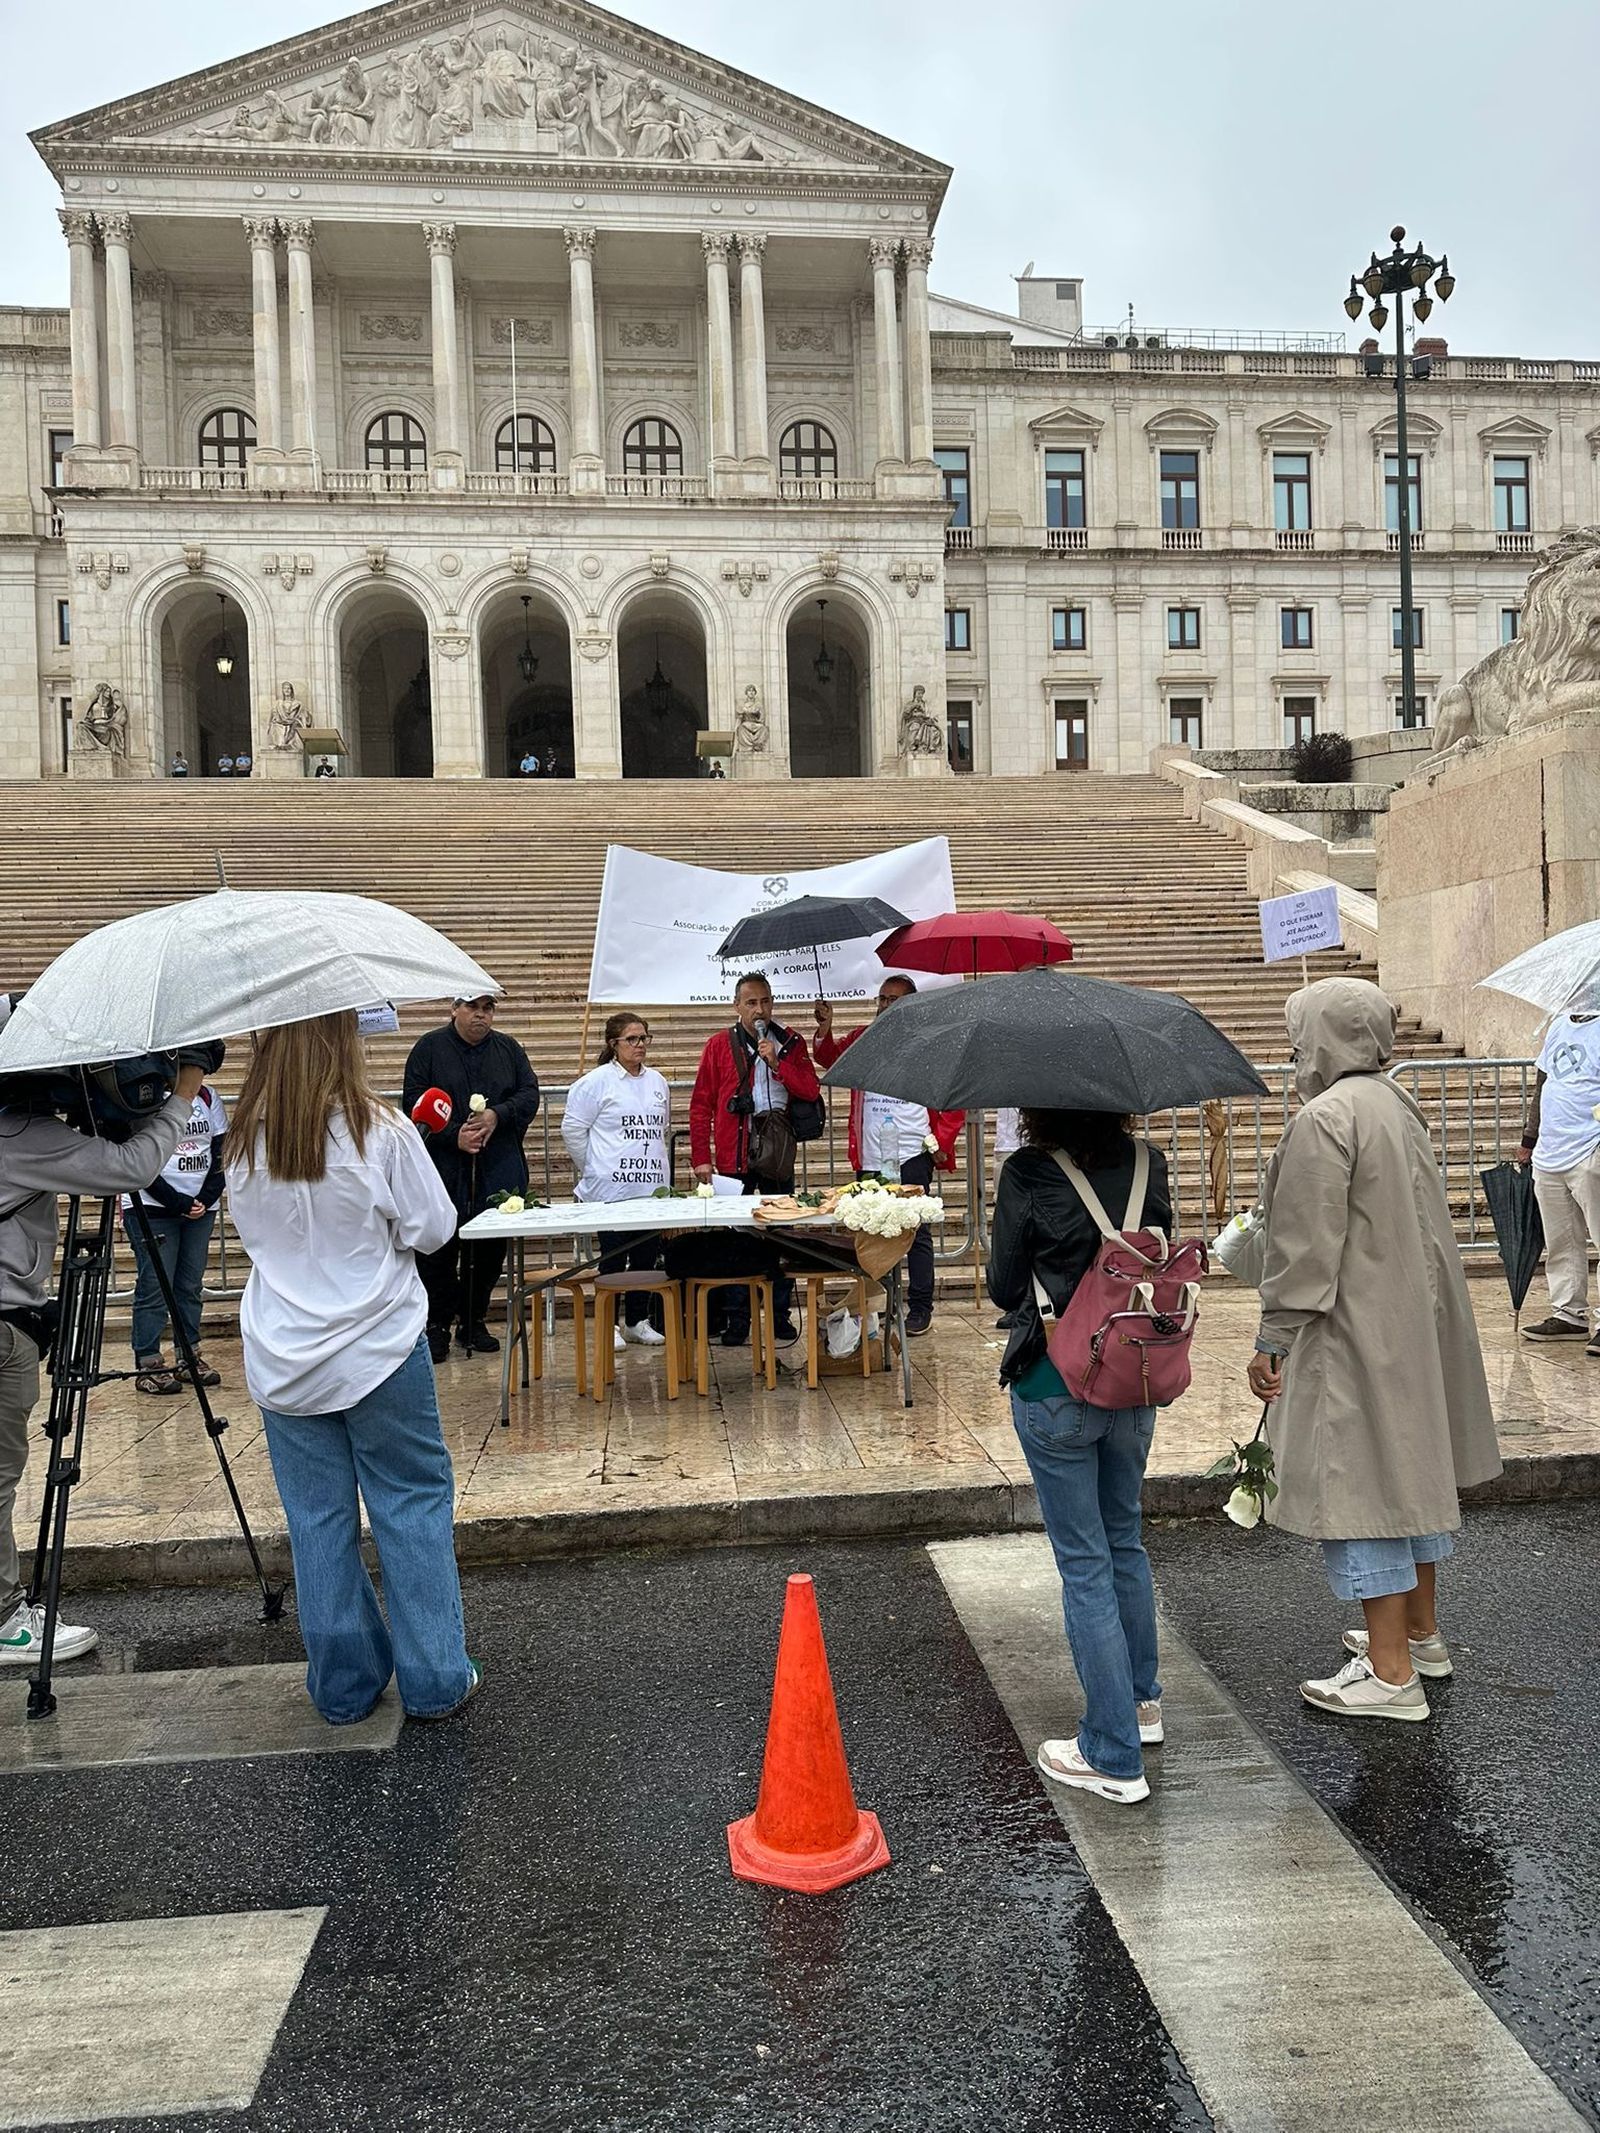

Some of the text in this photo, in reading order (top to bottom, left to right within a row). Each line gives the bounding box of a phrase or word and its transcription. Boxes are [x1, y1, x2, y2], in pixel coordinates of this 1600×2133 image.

[1286, 918, 1298, 926] QUE
[1299, 911, 1323, 922] FIZERAM
[673, 919, 717, 932] Associação
[719, 924, 730, 932] de
[1287, 928, 1296, 936] ATÉ
[745, 950, 791, 963] VERGONHA
[795, 946, 817, 956] PARA
[822, 943, 841, 953] ELES
[720, 969, 743, 978] PARA
[773, 966, 780, 975] A
[783, 961, 832, 975] CORAGEM!
[814, 988, 867, 999] OCULTAÇÃO
[621, 1114, 664, 1127] ERA UMA
[185, 1120, 209, 1135] RADO
[623, 1128, 662, 1140] MENINA
[178, 1154, 209, 1171] CRIME
[619, 1157, 662, 1170] E FOI NA
[612, 1171, 664, 1184] SACRISTIA
